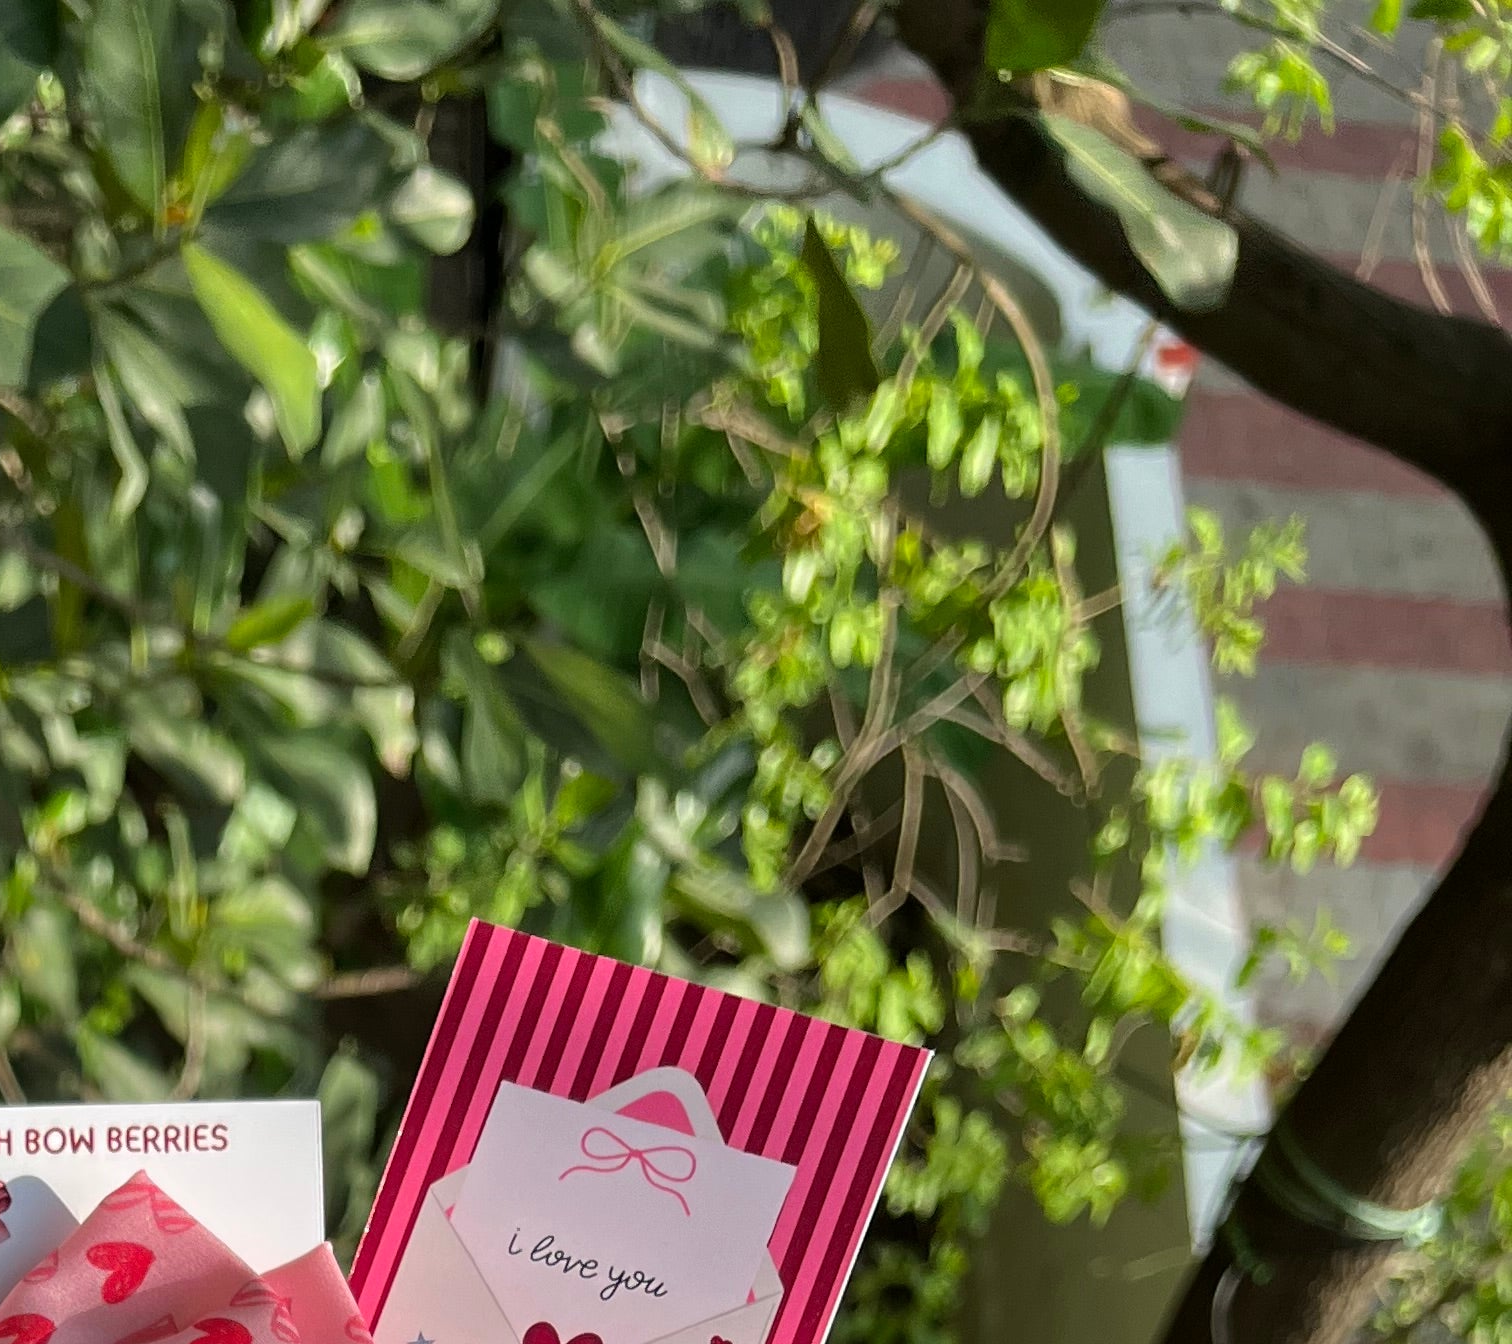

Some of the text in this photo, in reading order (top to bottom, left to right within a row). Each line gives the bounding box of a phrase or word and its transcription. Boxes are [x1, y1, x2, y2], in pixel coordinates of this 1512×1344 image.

[24, 1126, 94, 1155] BOW
[107, 1124, 229, 1153] BERRIES
[508, 1227, 668, 1301] i love you
